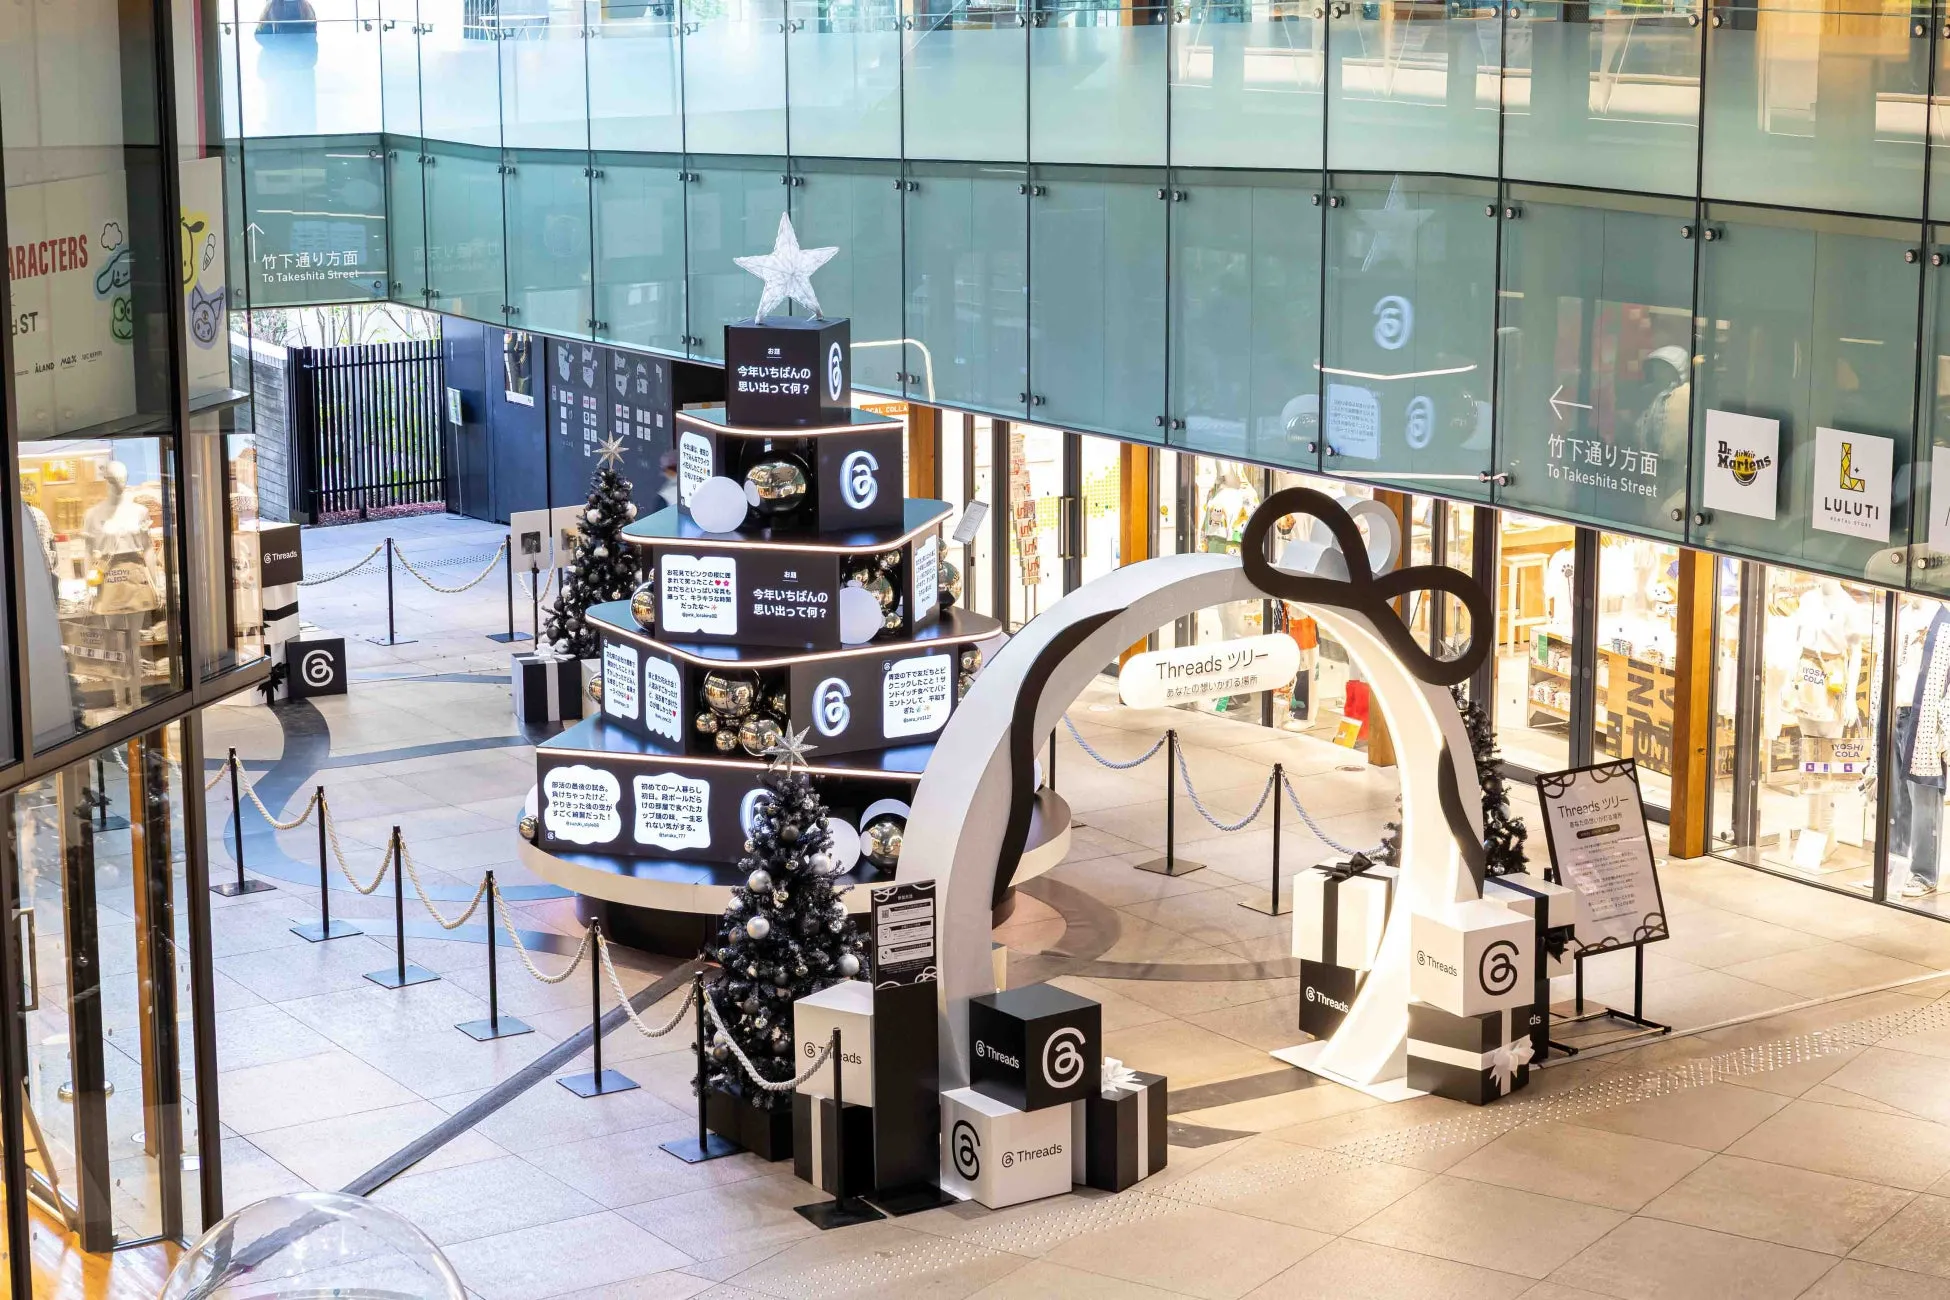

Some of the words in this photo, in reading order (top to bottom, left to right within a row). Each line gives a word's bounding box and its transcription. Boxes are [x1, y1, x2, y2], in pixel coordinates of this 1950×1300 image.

[262, 250, 358, 270] 竹下通り方面
[262, 273, 274, 282] To
[277, 271, 325, 282] Takeshita
[327, 270, 359, 279] Street
[737, 365, 811, 379] 今年いちばんの
[737, 380, 809, 395] 思い出って何？
[1548, 433, 1659, 477] 竹下通り方面
[1717, 454, 1771, 472] Martens
[1547, 463, 1560, 479] To
[1562, 466, 1617, 490] Takeshita
[1620, 477, 1657, 498] Street
[1825, 497, 1879, 520] LULUTI
[272, 550, 298, 561] Threads
[753, 588, 829, 603] 今年いちばんの
[753, 603, 827, 619] 思い出って何？
[1156, 654, 1222, 680] Threads
[1228, 648, 1268, 670] ツリー
[641, 783, 702, 794] 初めての一人暮らし
[641, 802, 703, 813] けの部屋で食べたカ
[1557, 800, 1600, 819] Threads
[1602, 796, 1629, 810] ツリー
[645, 821, 696, 832] れない気がする。
[1427, 955, 1458, 977] Threads
[1316, 990, 1349, 1014] Threads
[818, 1045, 862, 1065] Tads
[986, 1045, 1020, 1069] Threads
[1017, 1143, 1063, 1162] Threads
